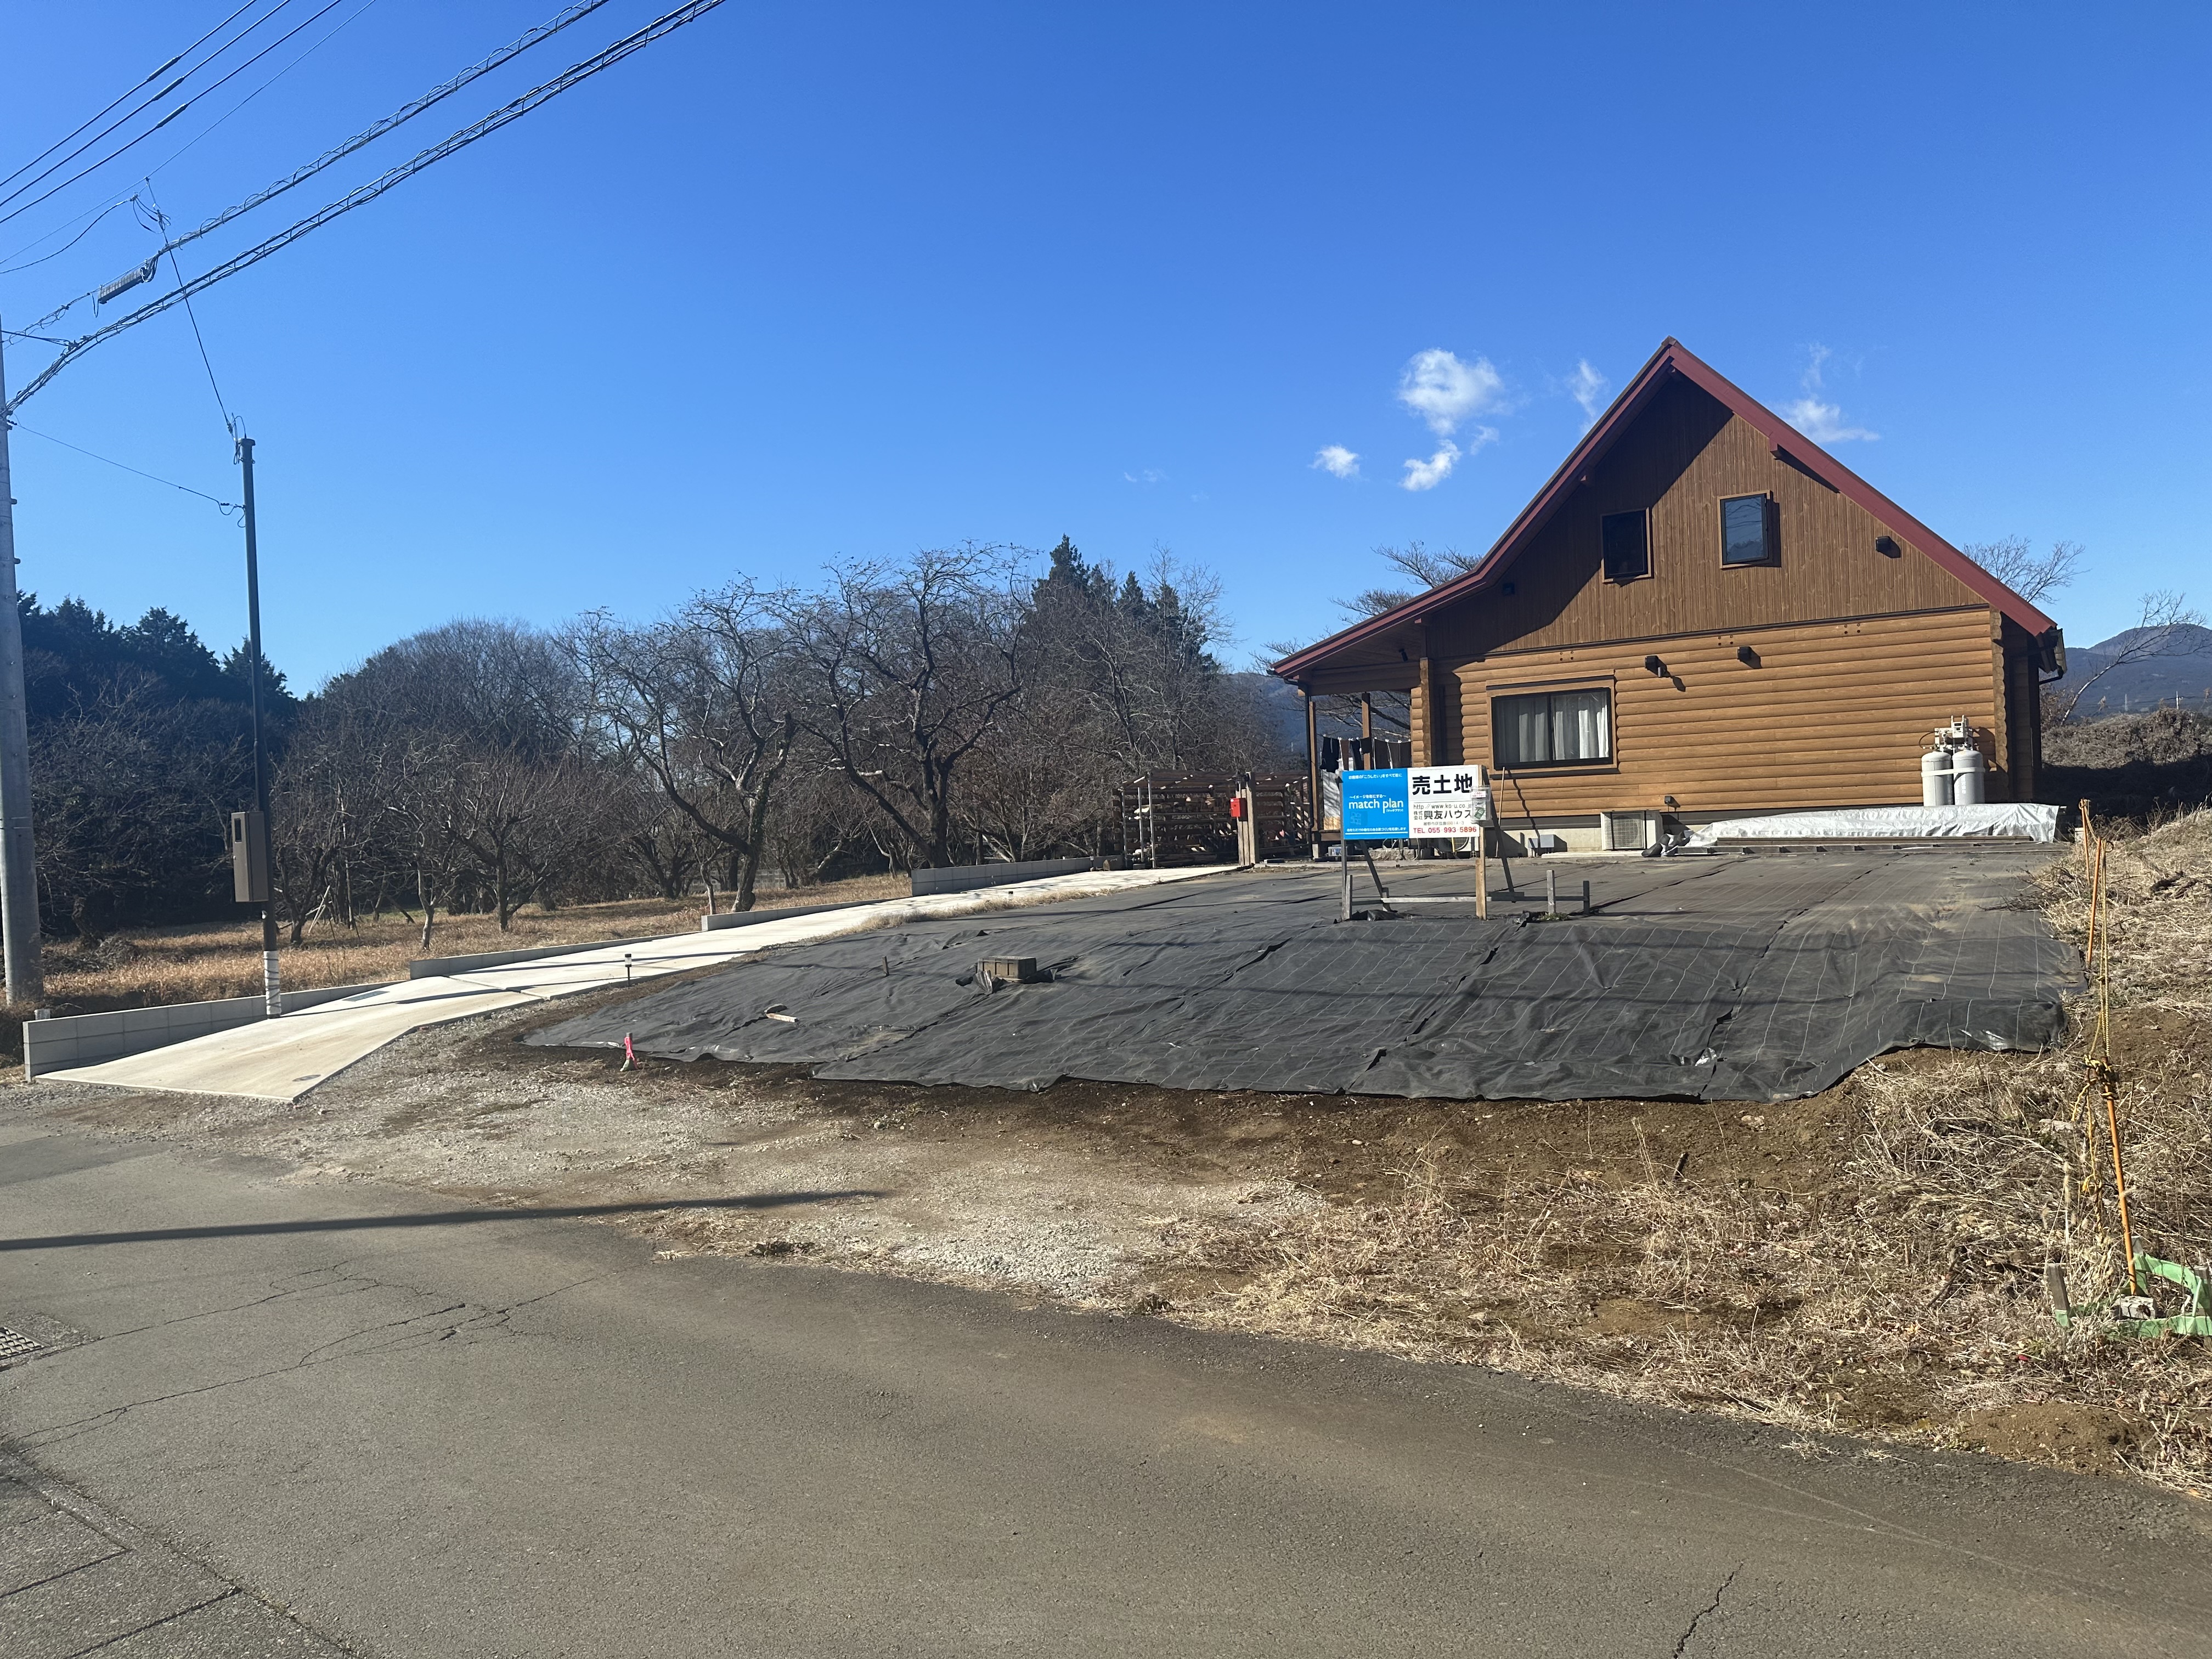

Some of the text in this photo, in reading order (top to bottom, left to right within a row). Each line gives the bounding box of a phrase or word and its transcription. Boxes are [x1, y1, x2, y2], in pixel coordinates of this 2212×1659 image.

[1412, 773, 1472, 795] 売土地
[1348, 798, 1404, 814] match plan
